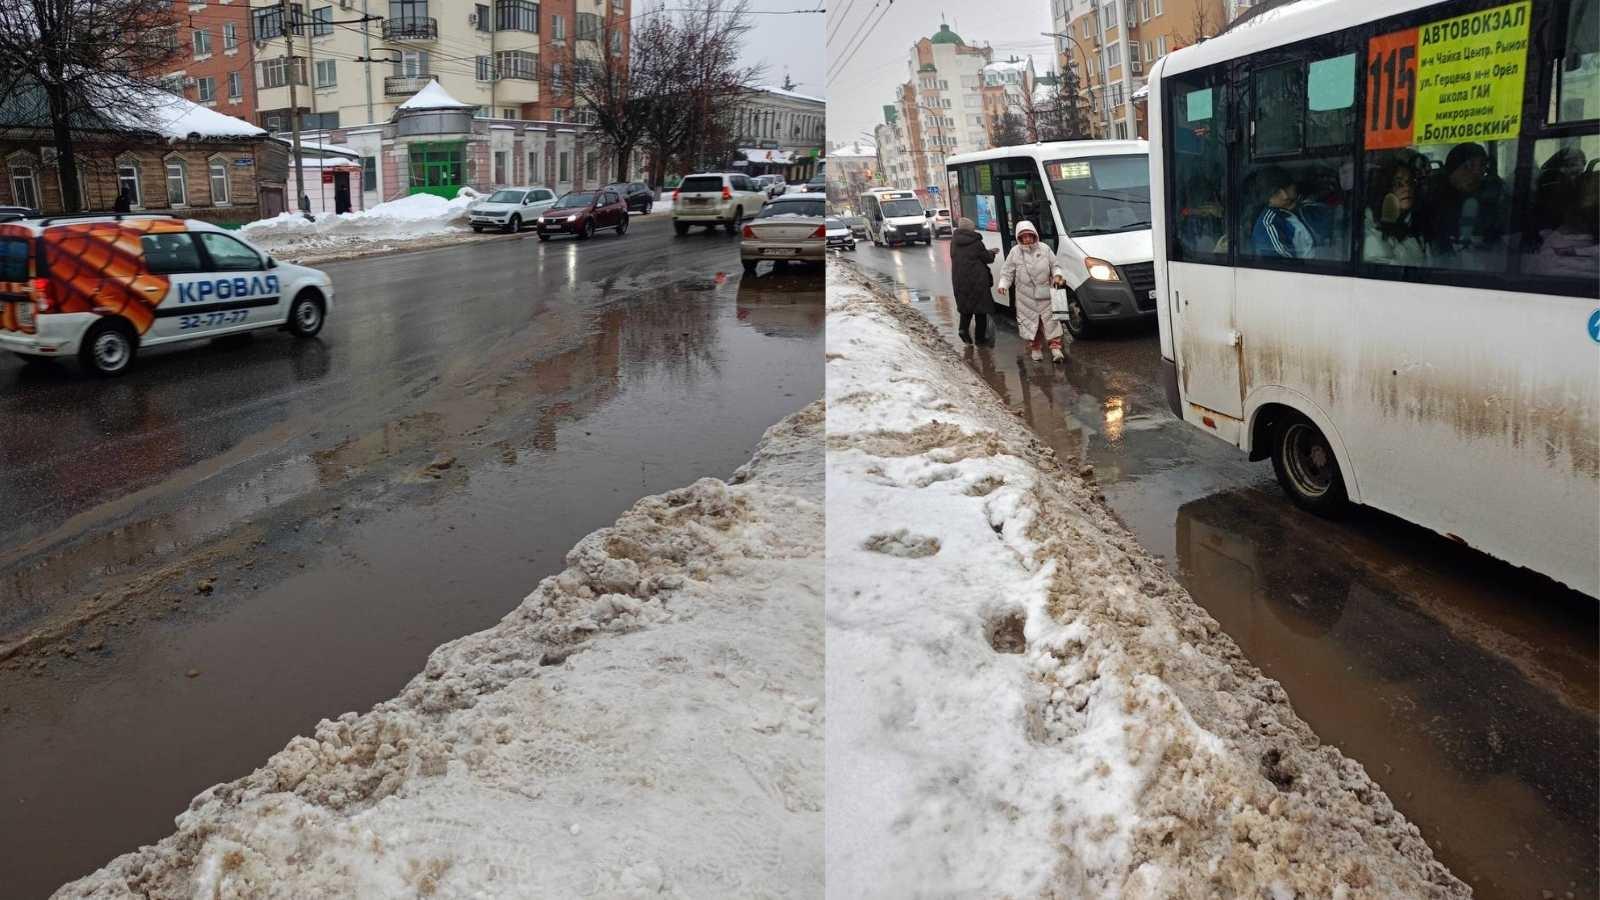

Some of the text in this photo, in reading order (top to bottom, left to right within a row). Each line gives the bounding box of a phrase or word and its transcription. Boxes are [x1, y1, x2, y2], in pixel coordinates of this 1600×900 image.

[1423, 6, 1526, 46] АВТОВОКЗАЛ
[1421, 39, 1528, 67] м-н Чайка Центр. Рынок
[1369, 46, 1416, 131] 115
[1420, 78, 1433, 91] ул.
[1434, 71, 1472, 87] Герцена
[1474, 69, 1490, 80] м-н
[1439, 84, 1490, 104] школа ГАИ
[178, 275, 280, 303] КРОВЛЯ
[179, 309, 250, 330] 32-77-77
